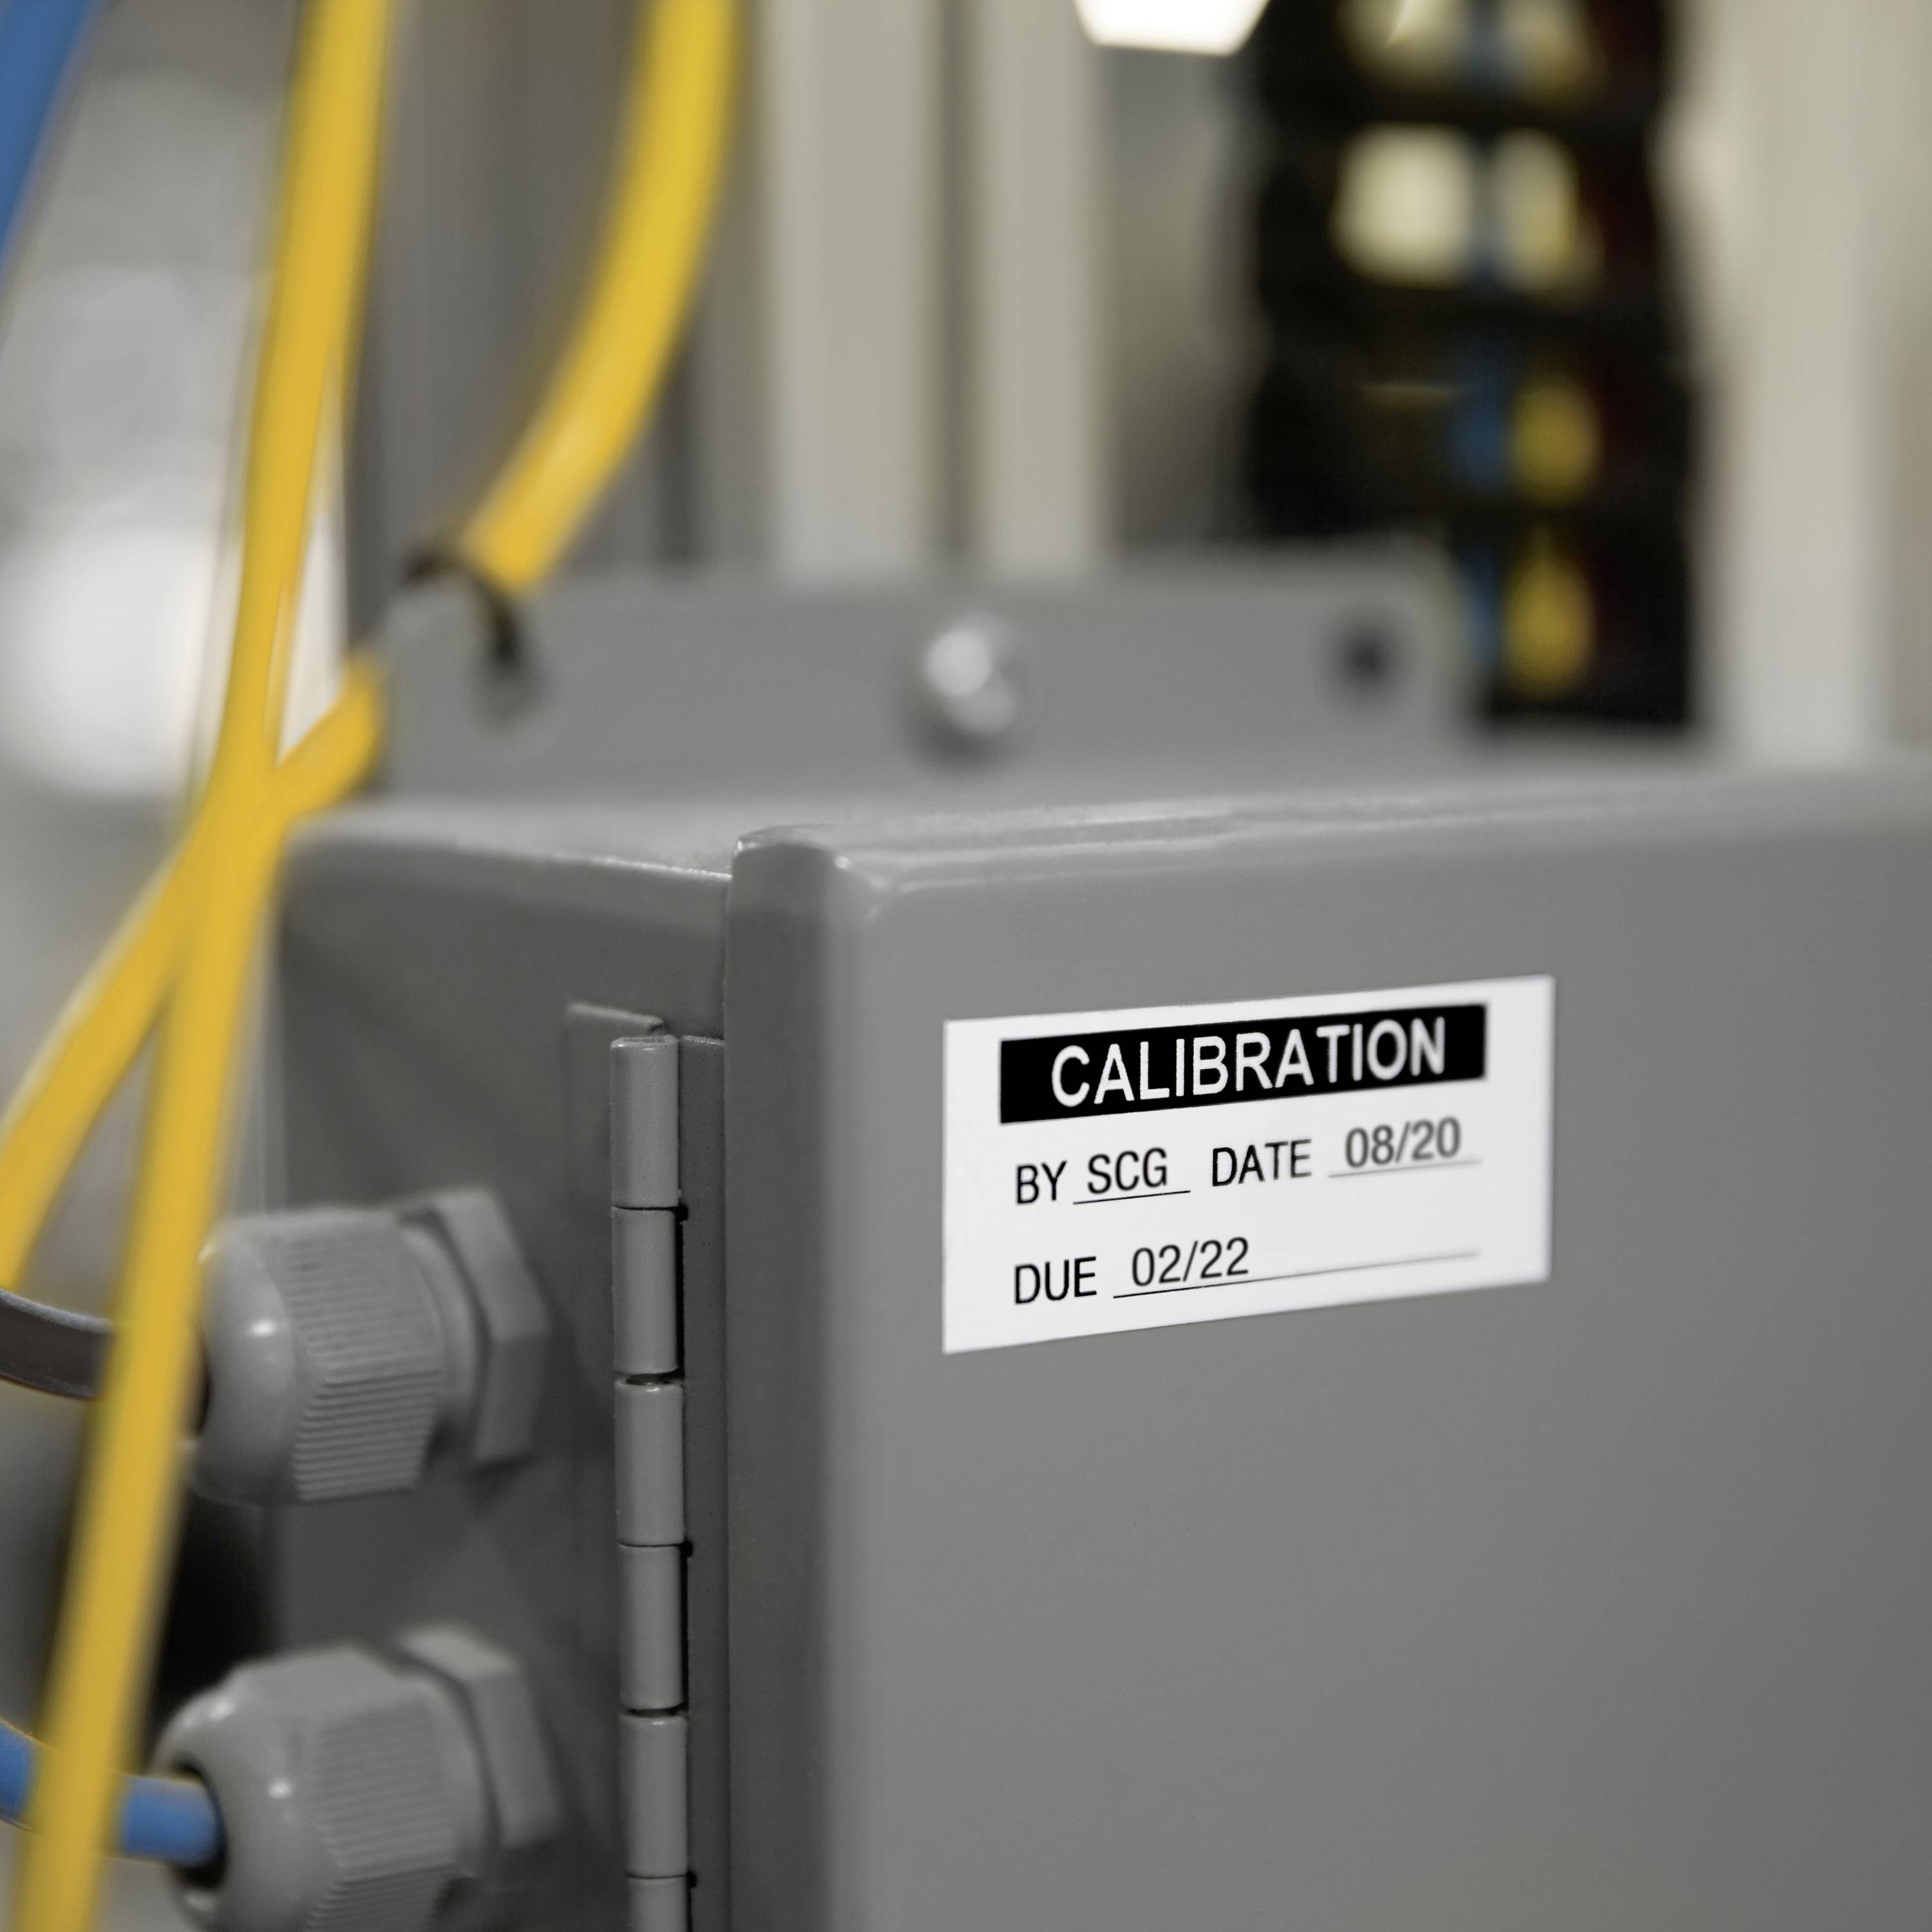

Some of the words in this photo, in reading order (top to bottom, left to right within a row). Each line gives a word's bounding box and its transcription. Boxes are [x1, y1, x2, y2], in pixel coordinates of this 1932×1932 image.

[1051, 1017, 1446, 1108] CALIBRATION
[1016, 1160, 1067, 1205] BY
[1086, 1147, 1168, 1195] SCG
[1211, 1139, 1312, 1187] DATE
[1345, 1117, 1461, 1169] 08/20
[1014, 1256, 1097, 1305] DUE
[1132, 1236, 1249, 1287] 02/22
